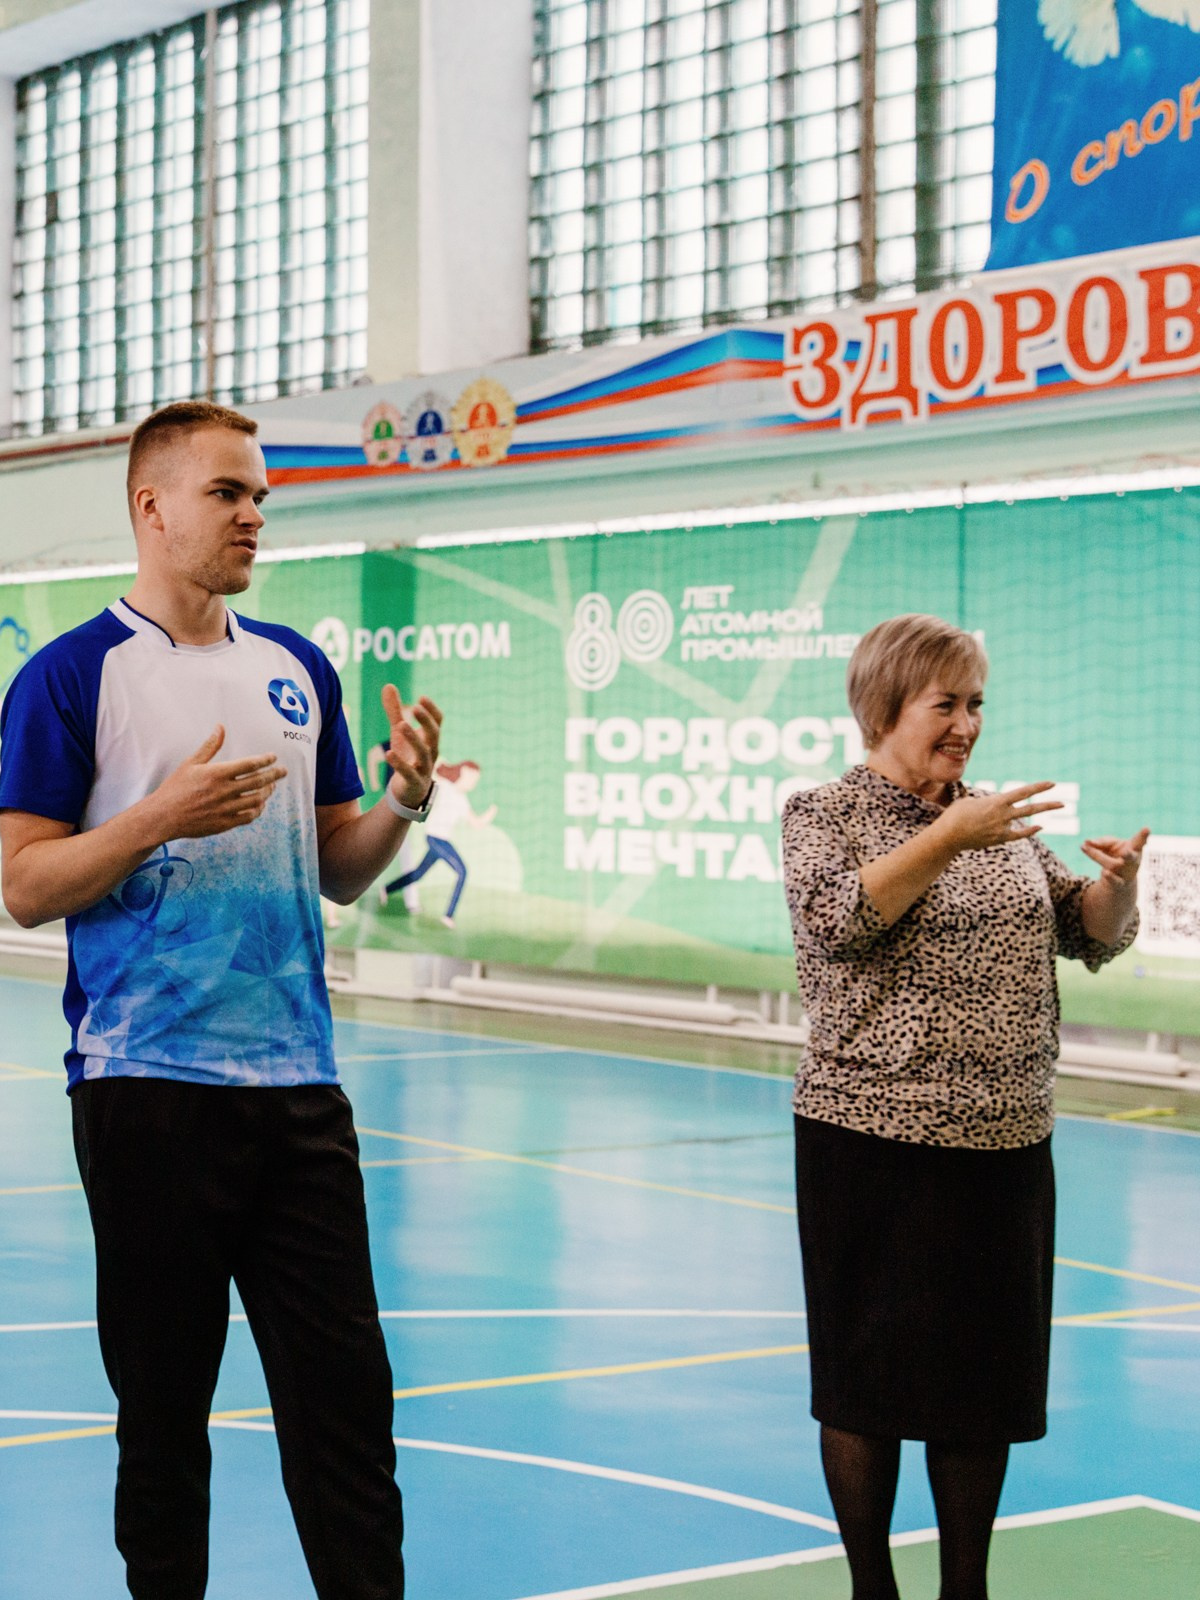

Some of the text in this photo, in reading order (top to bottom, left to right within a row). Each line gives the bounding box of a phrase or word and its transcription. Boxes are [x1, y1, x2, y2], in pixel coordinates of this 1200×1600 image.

[1005, 158, 1050, 224] О
[791, 262, 1200, 426] ЗДОРОВ
[680, 585, 734, 609] ЛЕТ
[680, 602, 823, 636] АТОМНОЙ
[353, 621, 511, 663] РОСАТОМ
[565, 589, 674, 691] 80
[564, 716, 864, 772] ГОРДОСТ
[564, 826, 784, 883] МЕЧТА
